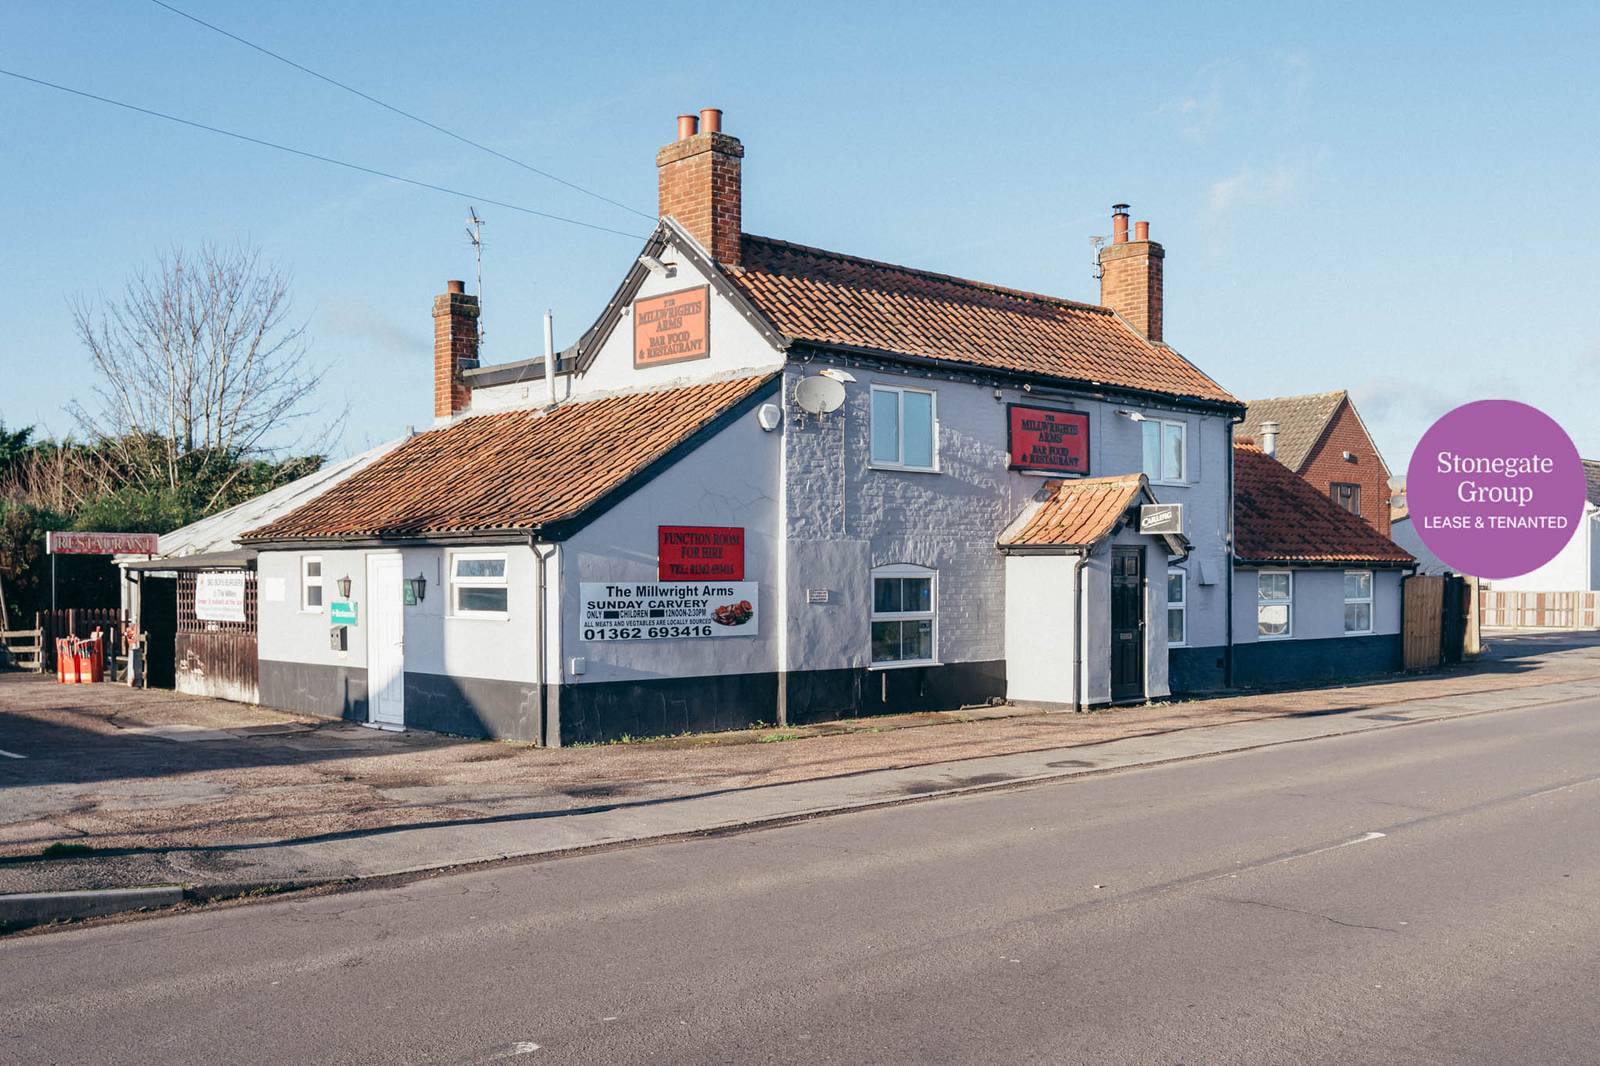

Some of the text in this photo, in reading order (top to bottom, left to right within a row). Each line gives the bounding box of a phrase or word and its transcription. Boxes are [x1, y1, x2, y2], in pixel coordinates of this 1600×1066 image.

[639, 301, 702, 325] MILLWRIGHTS
[656, 317, 682, 332] ARMS
[650, 331, 690, 347] BAR FOOD
[647, 339, 703, 358] RESTAURANT
[1022, 419, 1078, 435] MILLWRIGHTS
[1039, 432, 1063, 443] ARMS
[1032, 446, 1069, 457] BAR FOOD
[1030, 454, 1079, 467] RESTAURANT
[57, 536, 153, 550] RESTAURANT
[664, 532, 740, 545] FUNCTION ROOM
[682, 547, 723, 559] FOR HIRE
[606, 585, 734, 599] The Millwright Arms
[587, 599, 709, 609] SUNDAY CARVERY
[586, 611, 602, 619] ONLY
[620, 609, 648, 618] CHILDREN
[584, 626, 712, 640] 01362 693416
